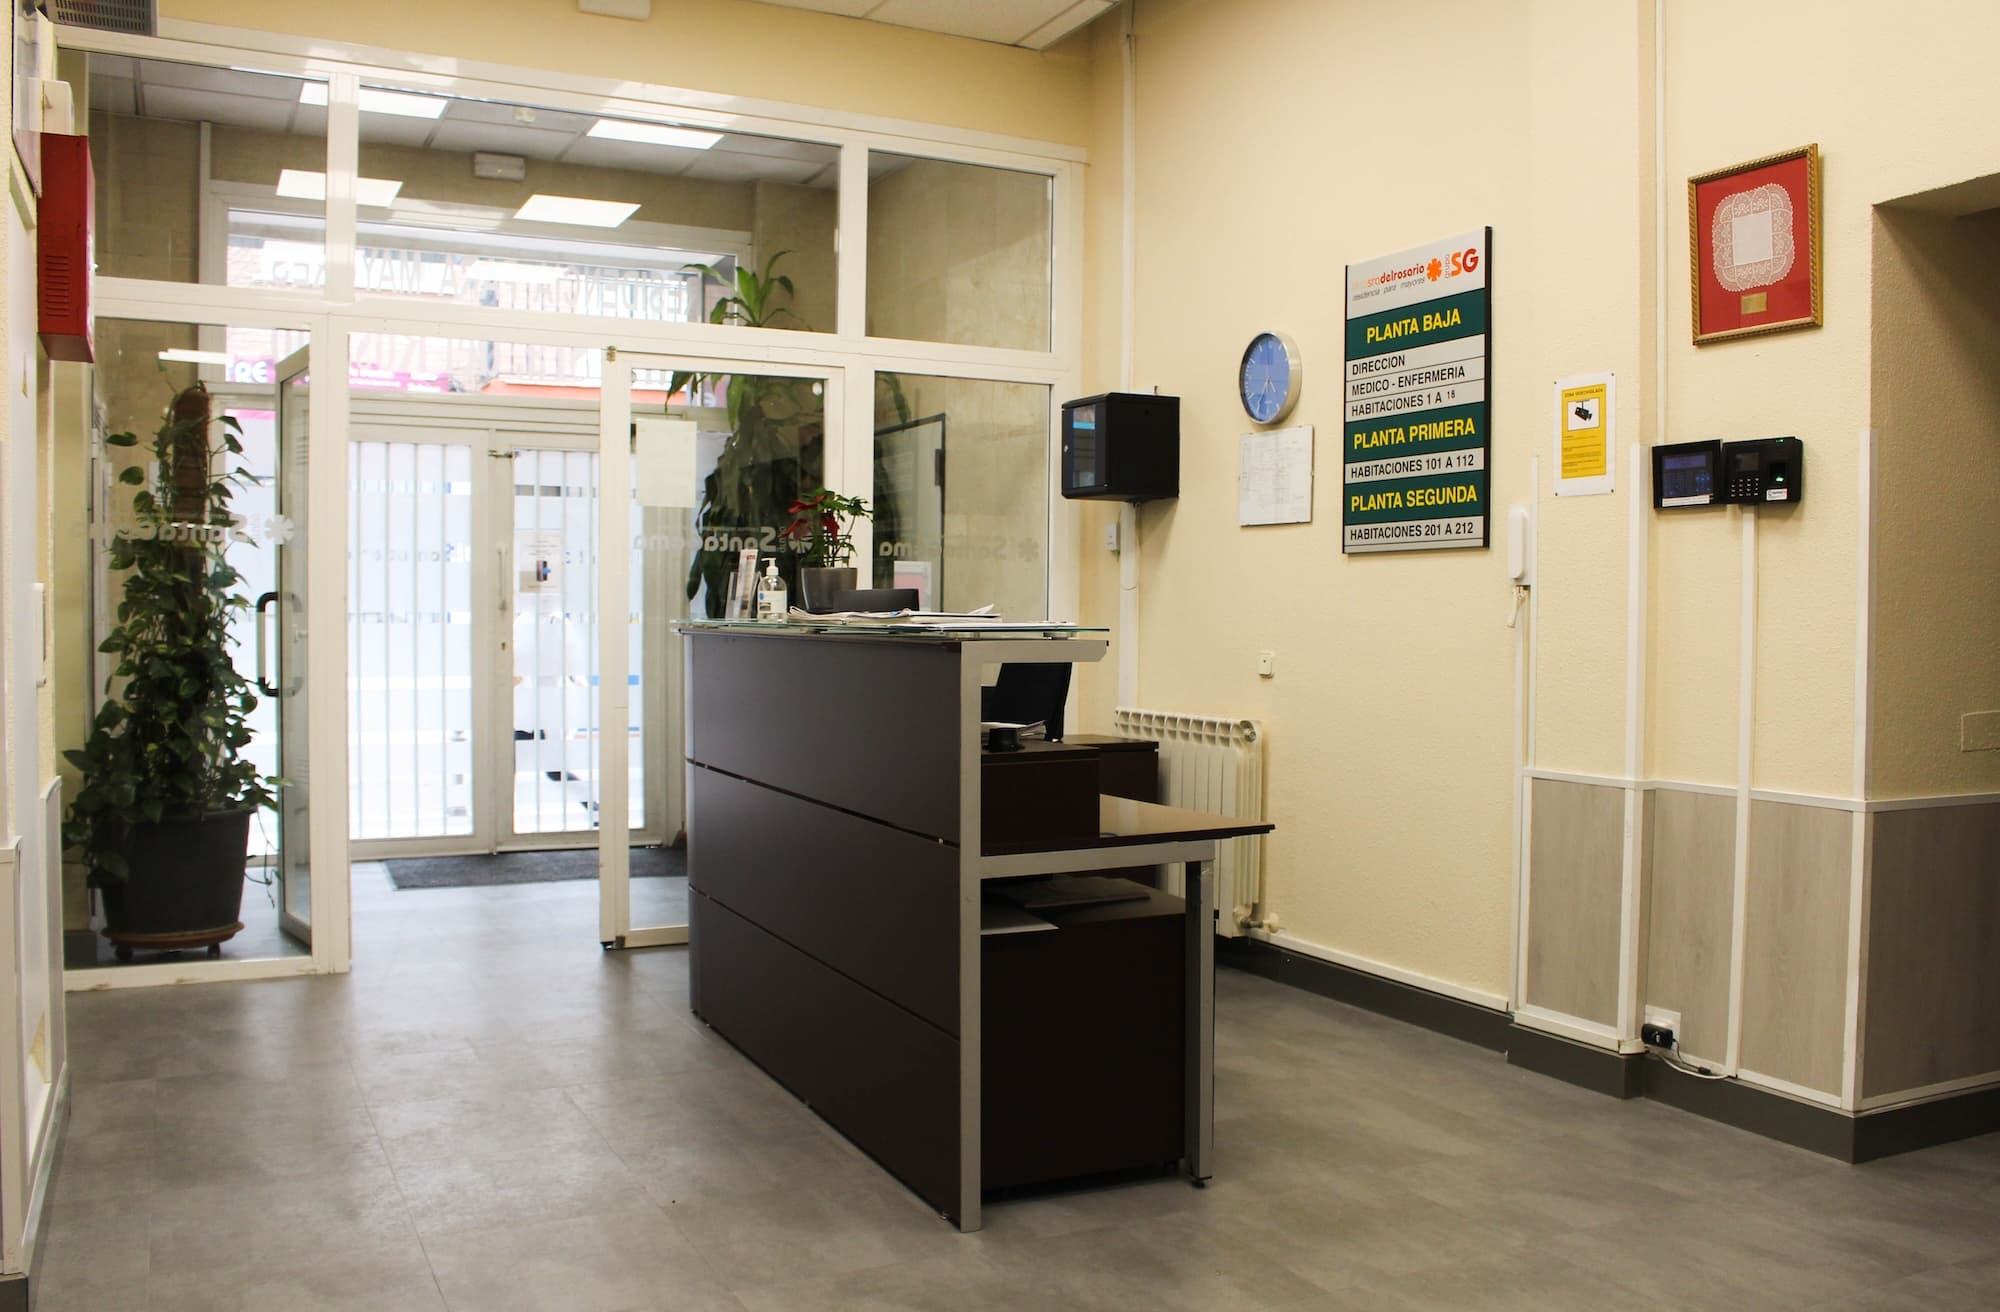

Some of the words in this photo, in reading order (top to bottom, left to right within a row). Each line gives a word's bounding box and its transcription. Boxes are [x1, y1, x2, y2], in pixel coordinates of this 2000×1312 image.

[1450, 248, 1479, 277] SG
[1366, 318, 1419, 344] PLANTA
[1423, 308, 1462, 332] BAJA
[1352, 355, 1406, 375] DIRECCION
[1352, 379, 1389, 396] MEDICO
[1398, 366, 1466, 388] ENFERMERIA
[1351, 395, 1424, 417] HABITACIONES
[1427, 393, 1432, 405] 1
[1435, 391, 1442, 404] A
[1353, 427, 1406, 449] PLANTA
[1409, 417, 1476, 443] PRIMERA
[1351, 459, 1423, 479] HABITACIONES
[1426, 457, 1442, 471] 101
[1445, 456, 1453, 468] A
[1456, 454, 1475, 467] 112
[1351, 491, 1403, 512] PLANTA
[1406, 484, 1478, 508] SEGUNDA
[1350, 524, 1422, 541] HABITACIONES
[1424, 523, 1442, 537] 201
[1445, 523, 1453, 536] A
[1455, 521, 1474, 535] 212
